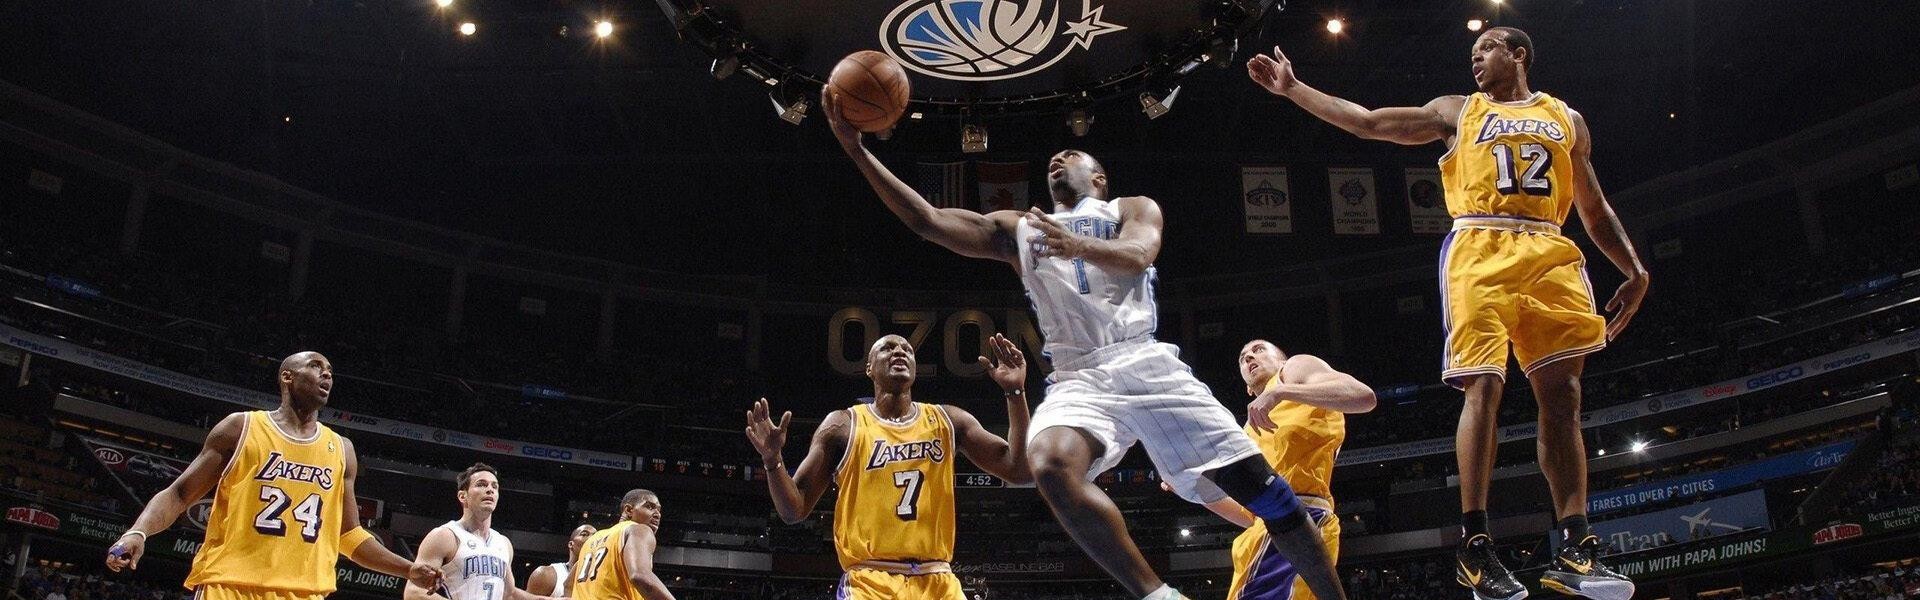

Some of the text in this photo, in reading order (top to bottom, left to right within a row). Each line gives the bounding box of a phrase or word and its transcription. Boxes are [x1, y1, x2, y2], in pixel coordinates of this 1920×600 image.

[1474, 113, 1565, 145] LAKERS
[1491, 142, 1552, 198] 12
[1071, 257, 1090, 294] 1
[1823, 353, 1871, 370] PEPSICO
[1747, 366, 1803, 390] GEICO
[99, 450, 119, 462] KIA
[522, 445, 572, 460] GEICO
[588, 458, 627, 469] PEPSICO
[866, 439, 945, 470] LAKERS
[253, 451, 334, 491] LAKERS
[966, 475, 992, 486] 4:52
[893, 469, 925, 521] 7
[1593, 495, 1622, 512] FARES
[1624, 493, 1636, 505] TO
[1639, 487, 1664, 502] OVER
[1682, 478, 1715, 496] CITIES
[70, 513, 95, 526] Better
[254, 485, 324, 544] 24
[1868, 510, 1895, 522] Better
[1883, 518, 1911, 529] Better
[81, 525, 107, 538] Better
[1610, 530, 1669, 554] Tran
[463, 554, 507, 580] MAGI
[1618, 561, 1645, 576] WIN
[1649, 556, 1680, 572] WITH
[1684, 548, 1717, 566] PAPA
[1720, 538, 1766, 560] JOHNS!
[337, 568, 400, 589] PA JOHNS!
